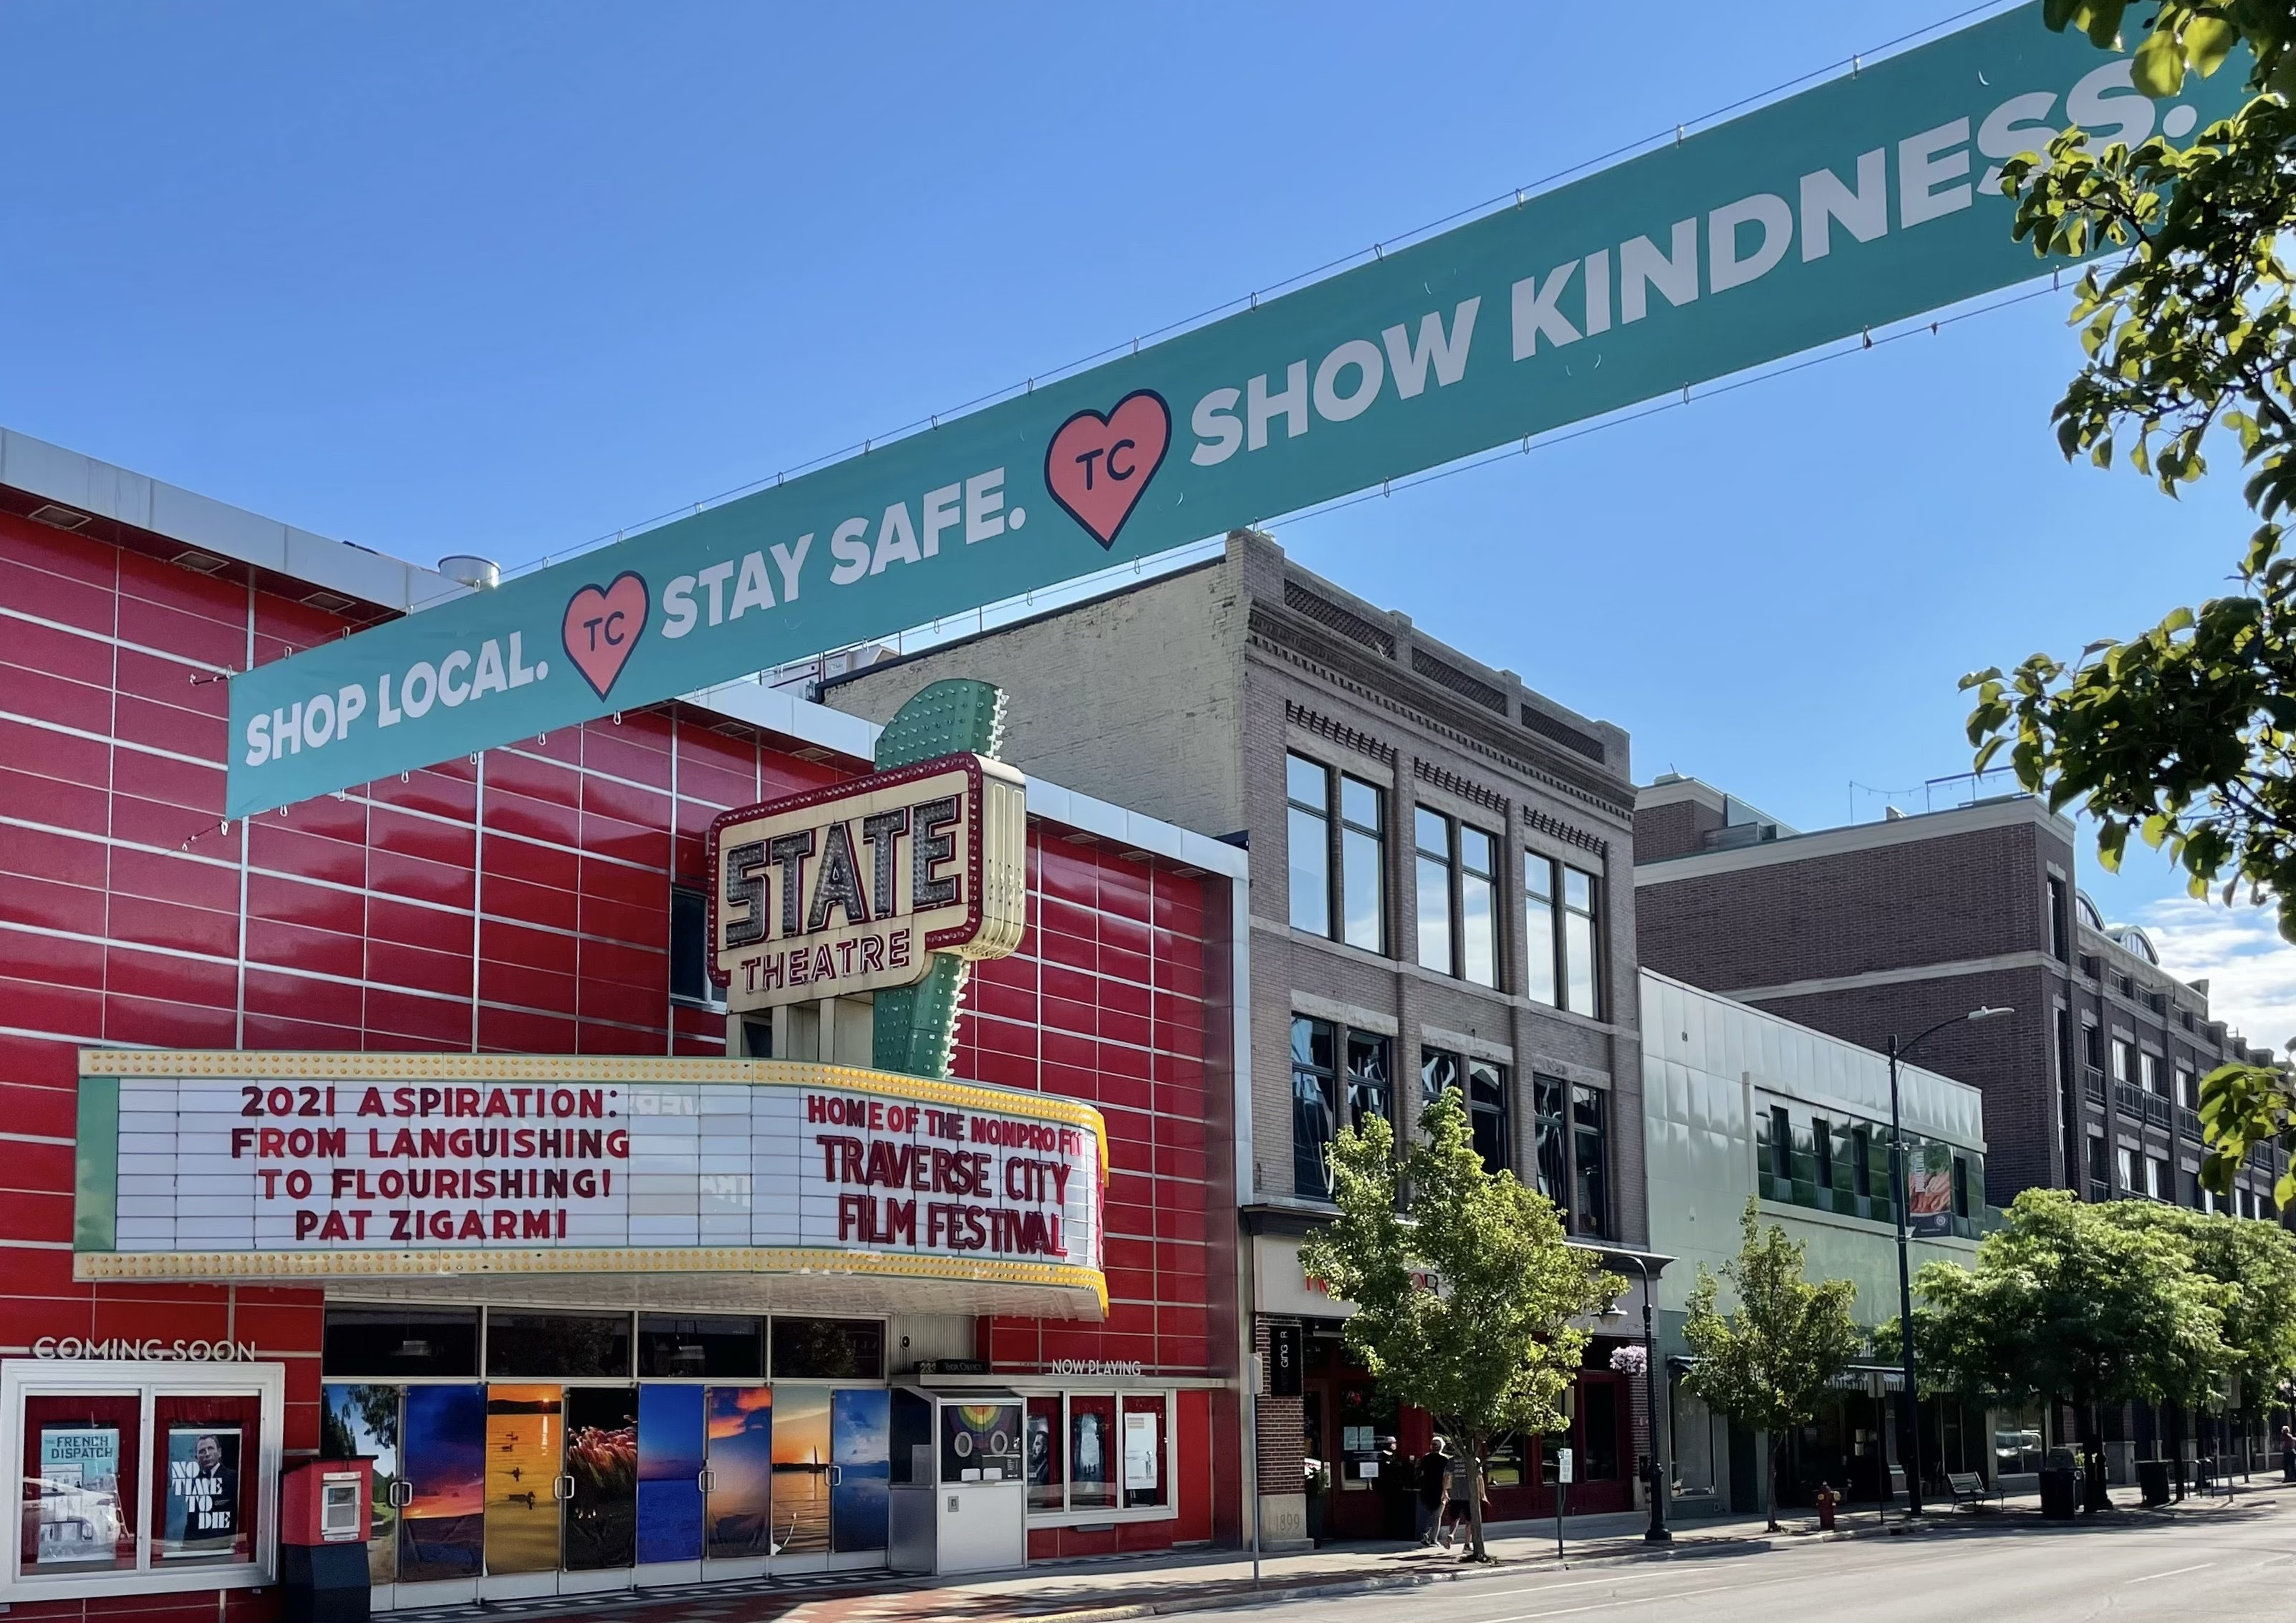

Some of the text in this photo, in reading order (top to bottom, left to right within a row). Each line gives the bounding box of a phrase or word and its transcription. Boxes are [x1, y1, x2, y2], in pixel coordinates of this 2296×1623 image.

[1190, 295, 1482, 467] SHOW
[1075, 439, 1136, 491] TC
[661, 467, 1026, 640] STAY SAFE.
[583, 611, 624, 652] TC
[245, 630, 549, 766] SHOP LOCAL.
[726, 794, 962, 949] STATE
[741, 928, 910, 994] THEATRE
[241, 1086, 335, 1117] 2021
[357, 1087, 618, 1118] ASPIRATION:
[807, 1095, 884, 1130] HOME
[887, 1105, 920, 1134] OF
[925, 1109, 965, 1141] THE
[231, 1127, 629, 1158] FROM LANGUISHING
[259, 1169, 611, 1199] TO FLOURISHING!
[816, 1135, 992, 1198] TRAVERSE
[1006, 1156, 1072, 1205] CITY
[296, 1209, 566, 1241] PAT ZIGARMI
[839, 1193, 1069, 1257] FILM FESTIVAL
[34, 1337, 256, 1362] COMING SOON
[1052, 1359, 1141, 1376] NOW PLAYING
[51, 1447, 113, 1459] DISPATCH
[57, 1435, 108, 1448] FRENCH
[171, 1461, 200, 1478] NO
[172, 1478, 223, 1496] TIME
[185, 1495, 213, 1513] TO
[198, 1511, 231, 1529] DIE
[1275, 1513, 1301, 1531] 1899
